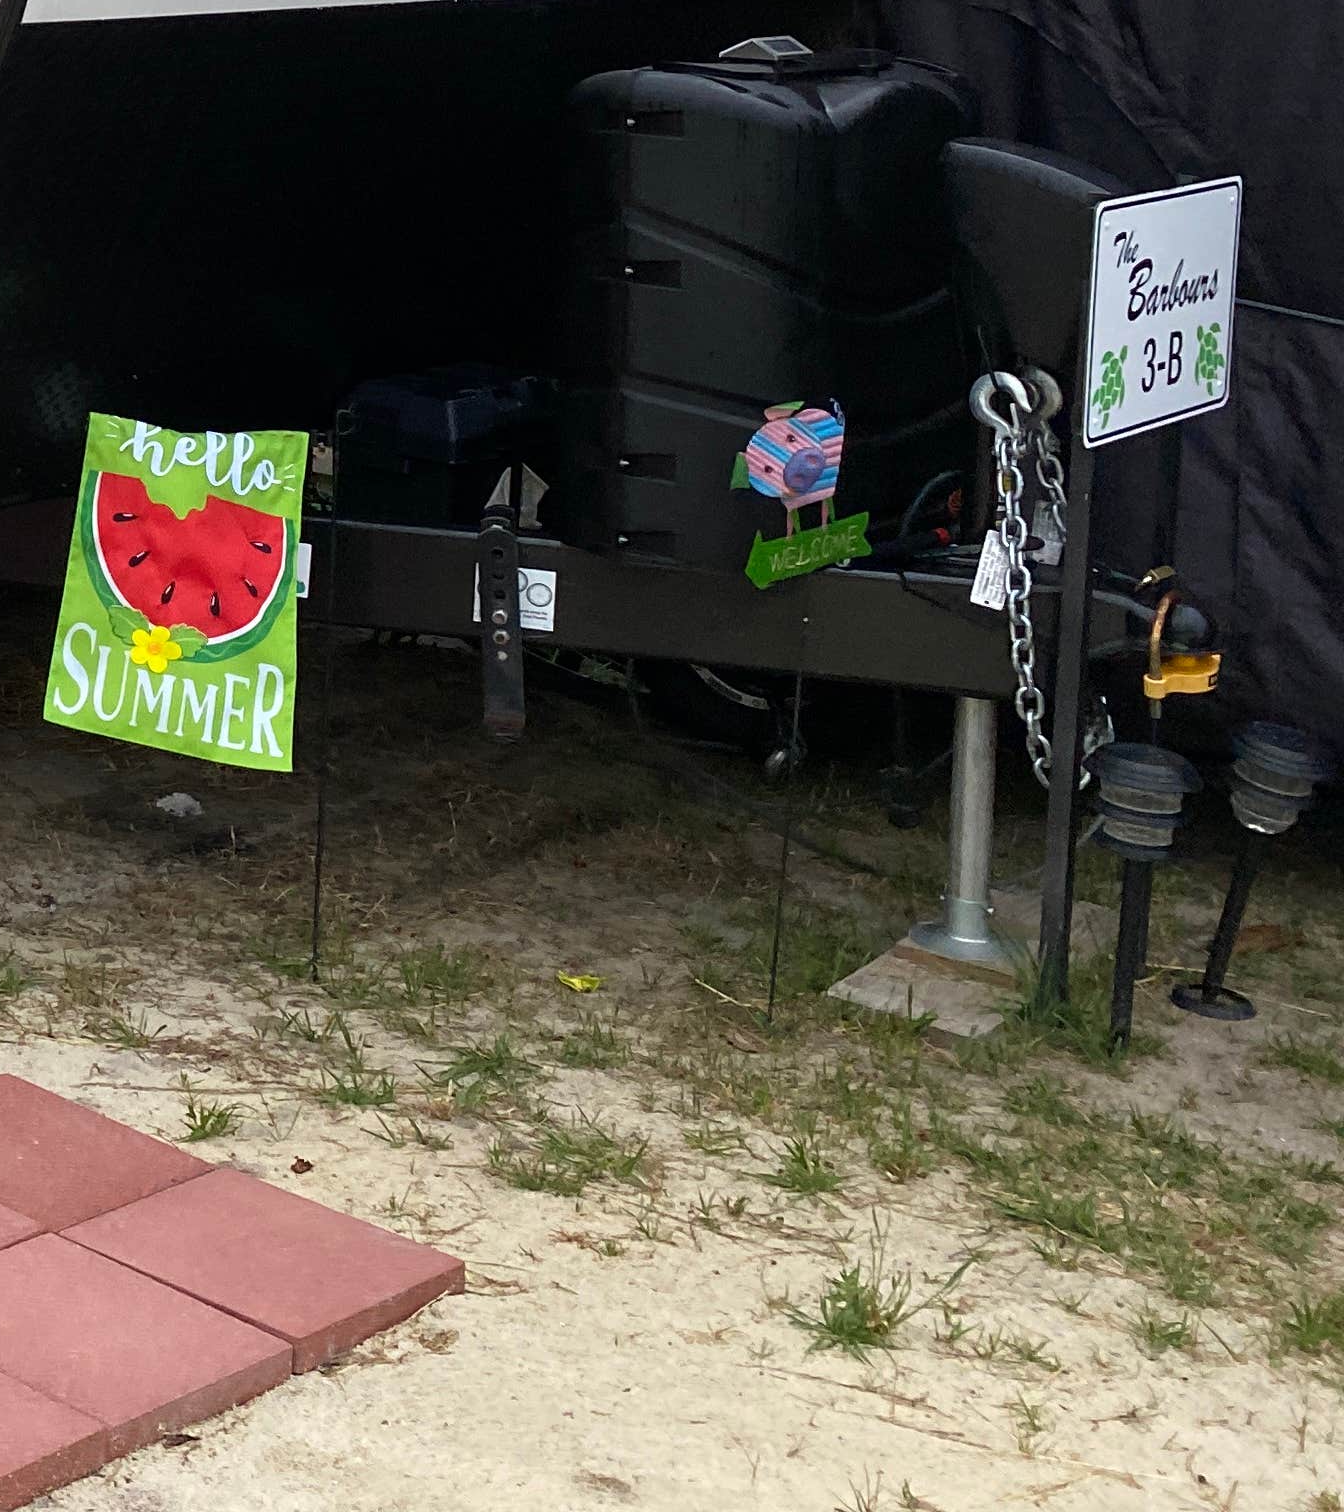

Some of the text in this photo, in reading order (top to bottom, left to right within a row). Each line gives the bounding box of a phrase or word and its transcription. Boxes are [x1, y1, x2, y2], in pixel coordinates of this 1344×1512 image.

[1113, 230, 1139, 268] The
[1127, 258, 1219, 321] Barbours
[1141, 331, 1182, 393] 3-B
[119, 420, 281, 496] hello
[769, 525, 859, 573] WELCOME
[52, 622, 284, 758] SUMMER
